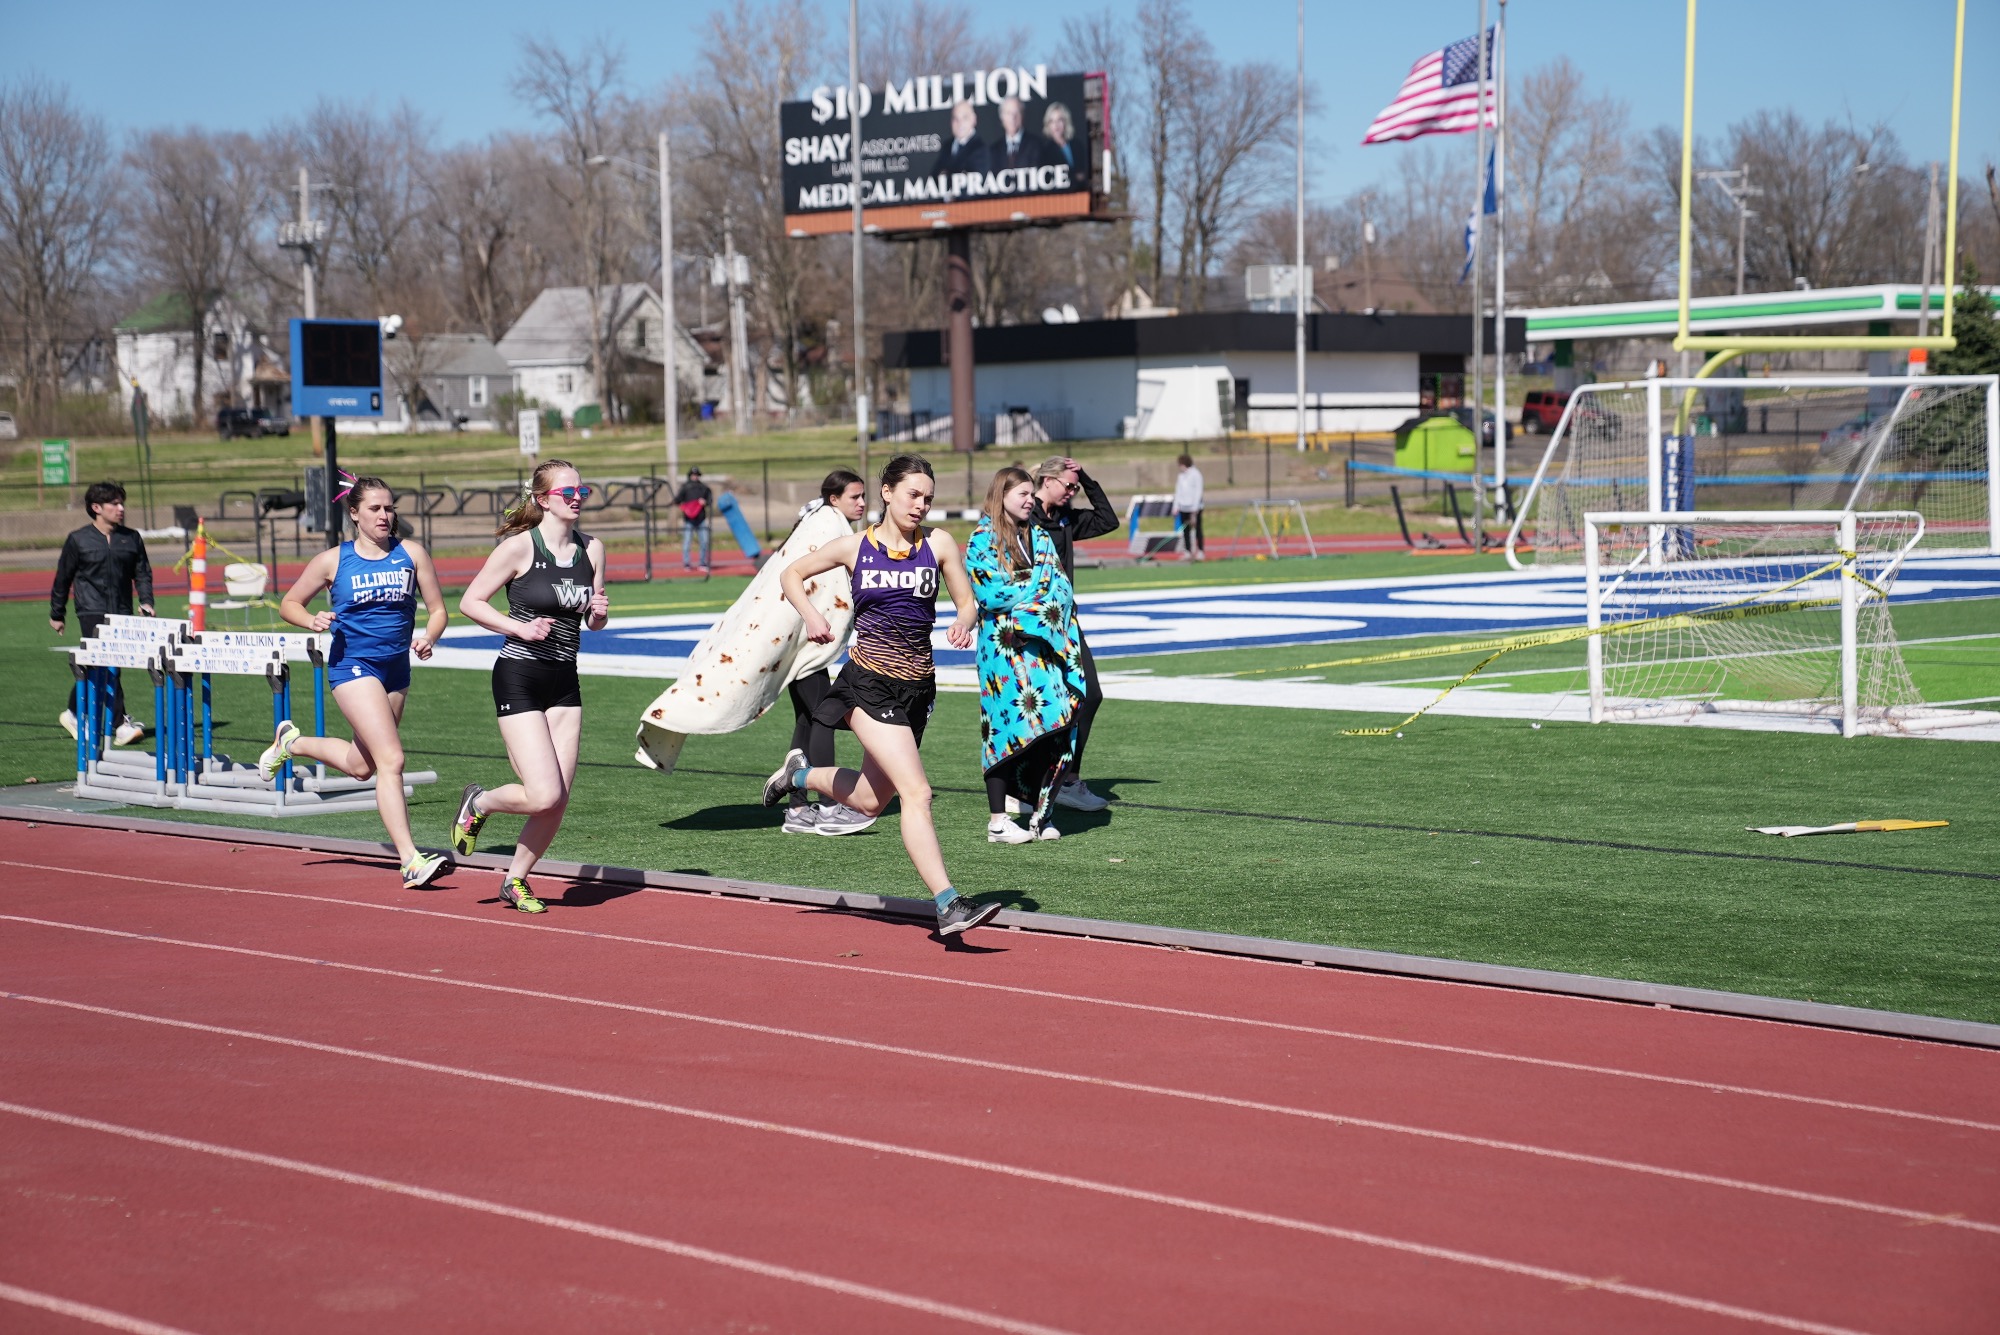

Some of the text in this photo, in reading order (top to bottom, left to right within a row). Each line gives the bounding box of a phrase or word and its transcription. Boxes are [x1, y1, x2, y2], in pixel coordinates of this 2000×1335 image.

[811, 64, 1048, 126] $10 MILLION
[785, 133, 850, 166] SHAY
[860, 133, 942, 157] ASSOCIATES
[886, 156, 909, 172] LLC
[903, 164, 1071, 200] MALPRACTICE
[861, 570, 917, 589] KNO
[919, 568, 933, 596] 8
[121, 627, 148, 642] MILLIKIN
[235, 634, 275, 648] MILLIKIN
